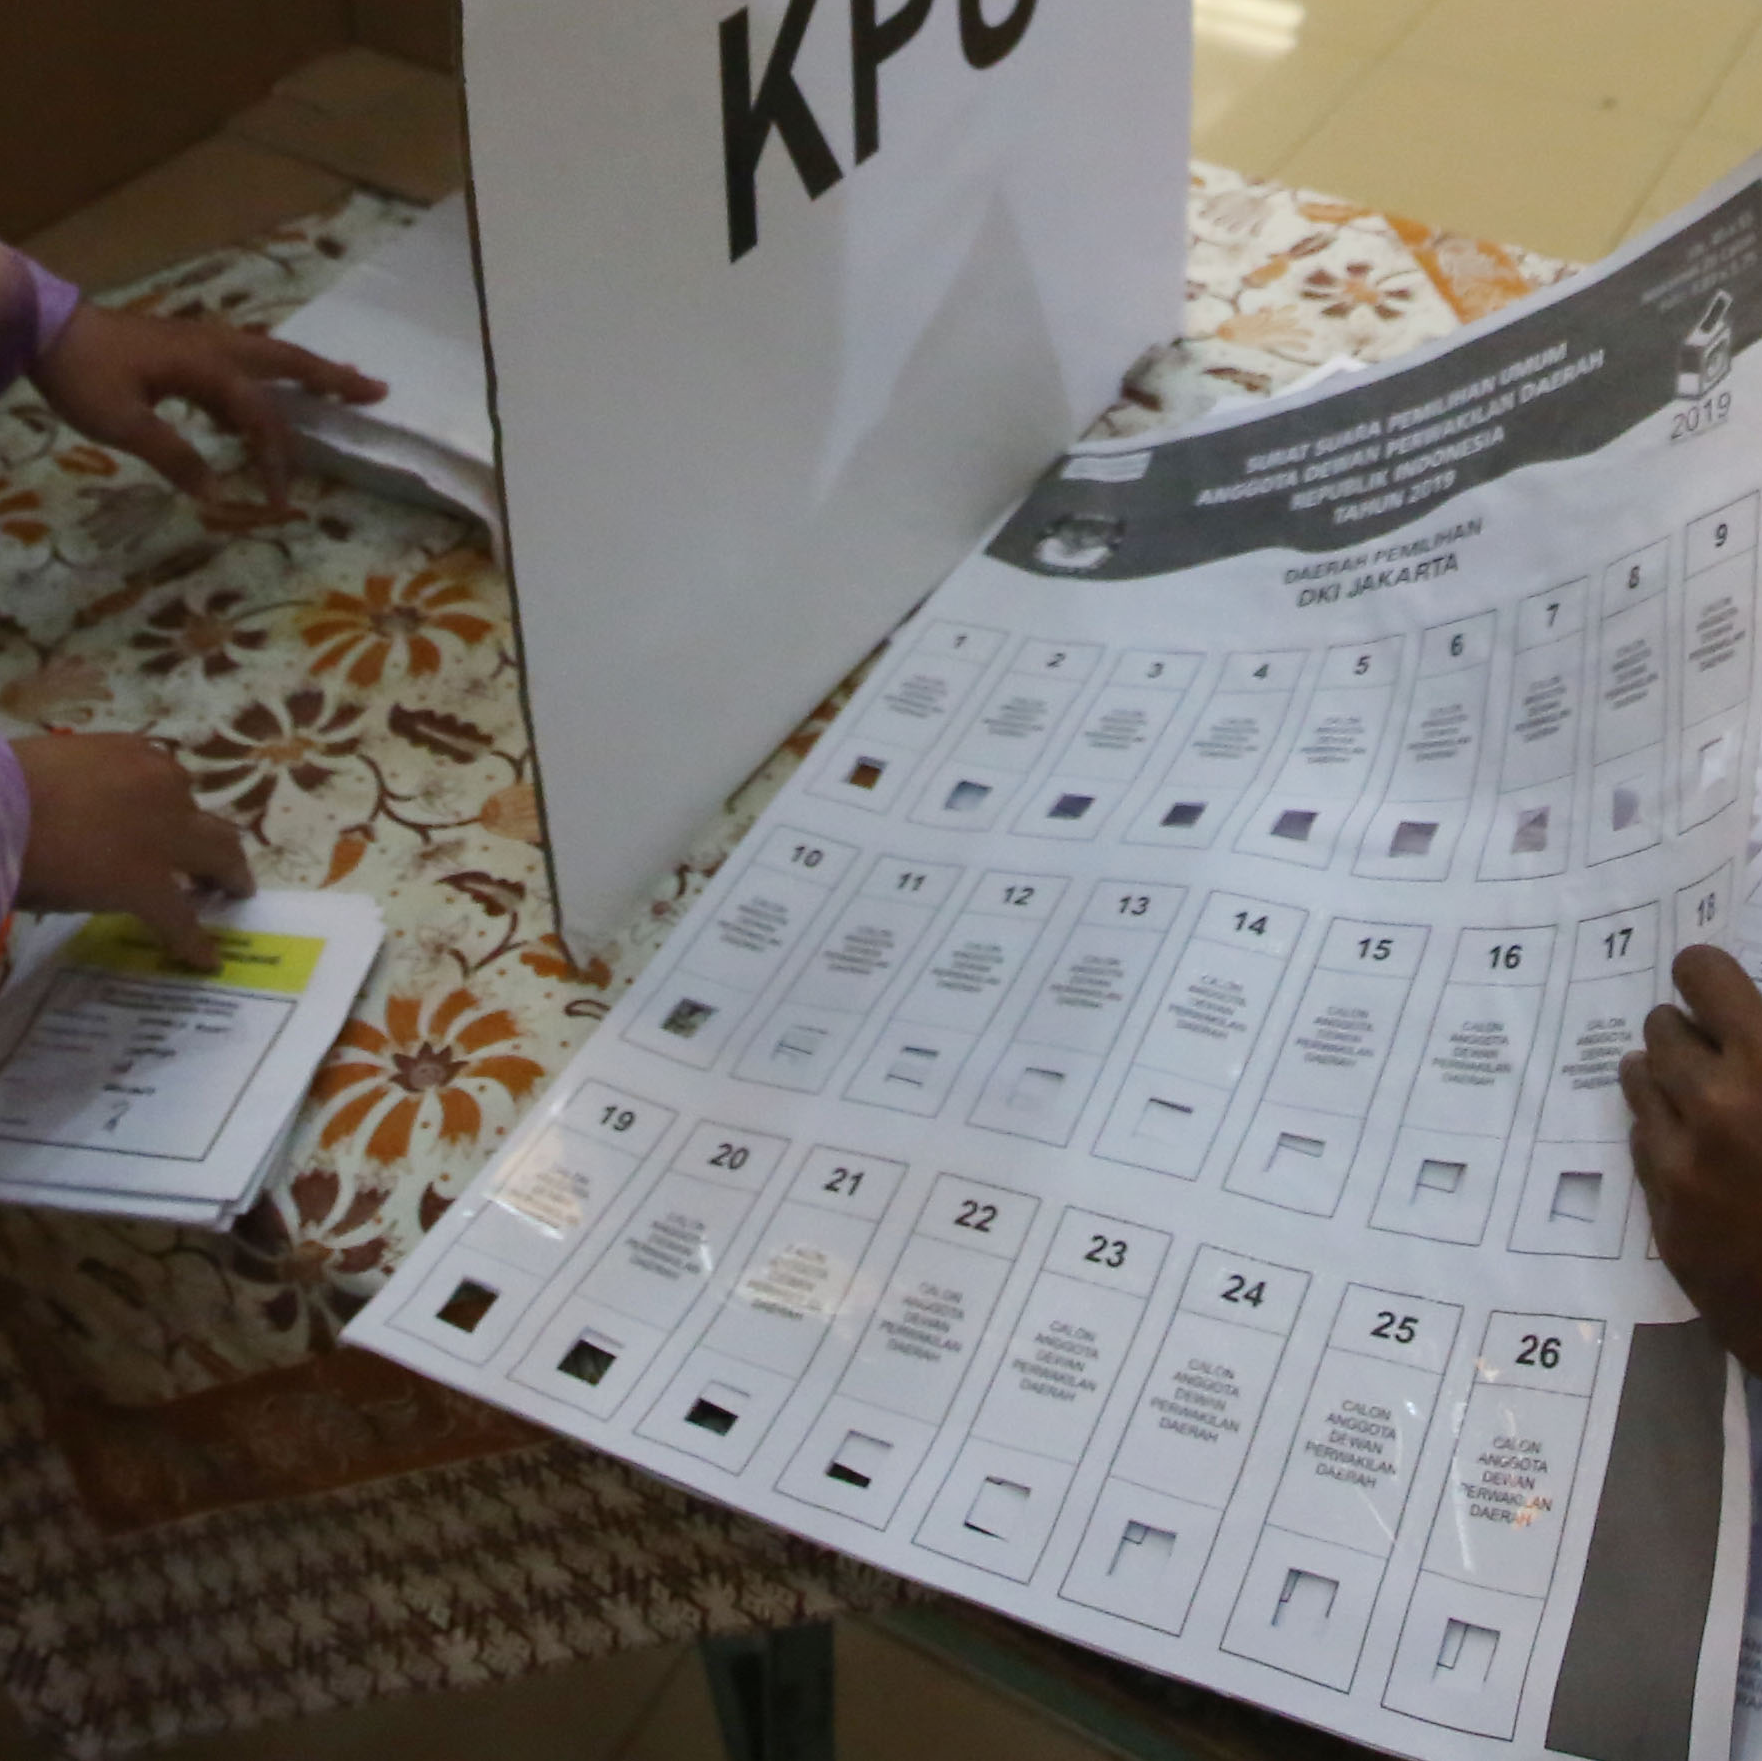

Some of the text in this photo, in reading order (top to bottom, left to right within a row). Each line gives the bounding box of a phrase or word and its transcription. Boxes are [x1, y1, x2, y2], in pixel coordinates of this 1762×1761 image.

[1314, 420, 1382, 456] SUARA
[1386, 375, 1496, 433] PEMILIHAN
[1498, 342, 1567, 386] UMUM
[1195, 469, 1299, 507] ANGGOTA
[1301, 444, 1382, 484] DEWAN
[1518, 349, 1605, 404] DAERAH
[1671, 392, 1731, 439] 2019
[1392, 425, 1505, 483] INDONESIA
[1334, 491, 1404, 523] TAHUN
[1715, 523, 1728, 548] 9
[1284, 517, 1482, 584] DAERAH PEMILIHAN
[1297, 552, 1458, 607] DKI JAKARTA
[1628, 565, 1640, 589] 8
[1546, 602, 1561, 627] 7
[954, 632, 967, 649] 1
[1450, 633, 1464, 657] 6
[1047, 652, 1066, 668] 2
[1147, 661, 1164, 679] 3
[1253, 663, 1269, 680] 4
[1353, 655, 1372, 676] 5
[791, 845, 824, 868] 10
[897, 872, 927, 891] 11
[1004, 886, 1035, 906] 12
[1119, 896, 1151, 915] 13
[1697, 892, 1716, 926] 18
[1235, 911, 1269, 936] 14
[1359, 938, 1394, 960] 15
[1605, 928, 1634, 959] 17
[1490, 944, 1523, 969] 16
[600, 1105, 636, 1131] 19
[708, 1143, 750, 1170] 20
[824, 1167, 865, 1196] 21
[954, 1199, 998, 1233] 22
[1084, 1235, 1128, 1268] 23
[1221, 1274, 1266, 1307] 24
[1370, 1311, 1419, 1344] 25
[1515, 1334, 1561, 1369] 26
[1189, 1358, 1234, 1379] CALON
[1342, 1400, 1391, 1420] CALON
[1326, 1413, 1396, 1439] ANGGOTA
[1328, 1429, 1383, 1454] DEWAN
[1492, 1436, 1542, 1454] CALON
[1305, 1440, 1396, 1475] PERWAKILAN
[1478, 1453, 1548, 1473] ANGGOTA
[1315, 1463, 1377, 1488] DAERAH
[1482, 1470, 1535, 1490] DEWAN
[1470, 1504, 1532, 1527] DAERAH
